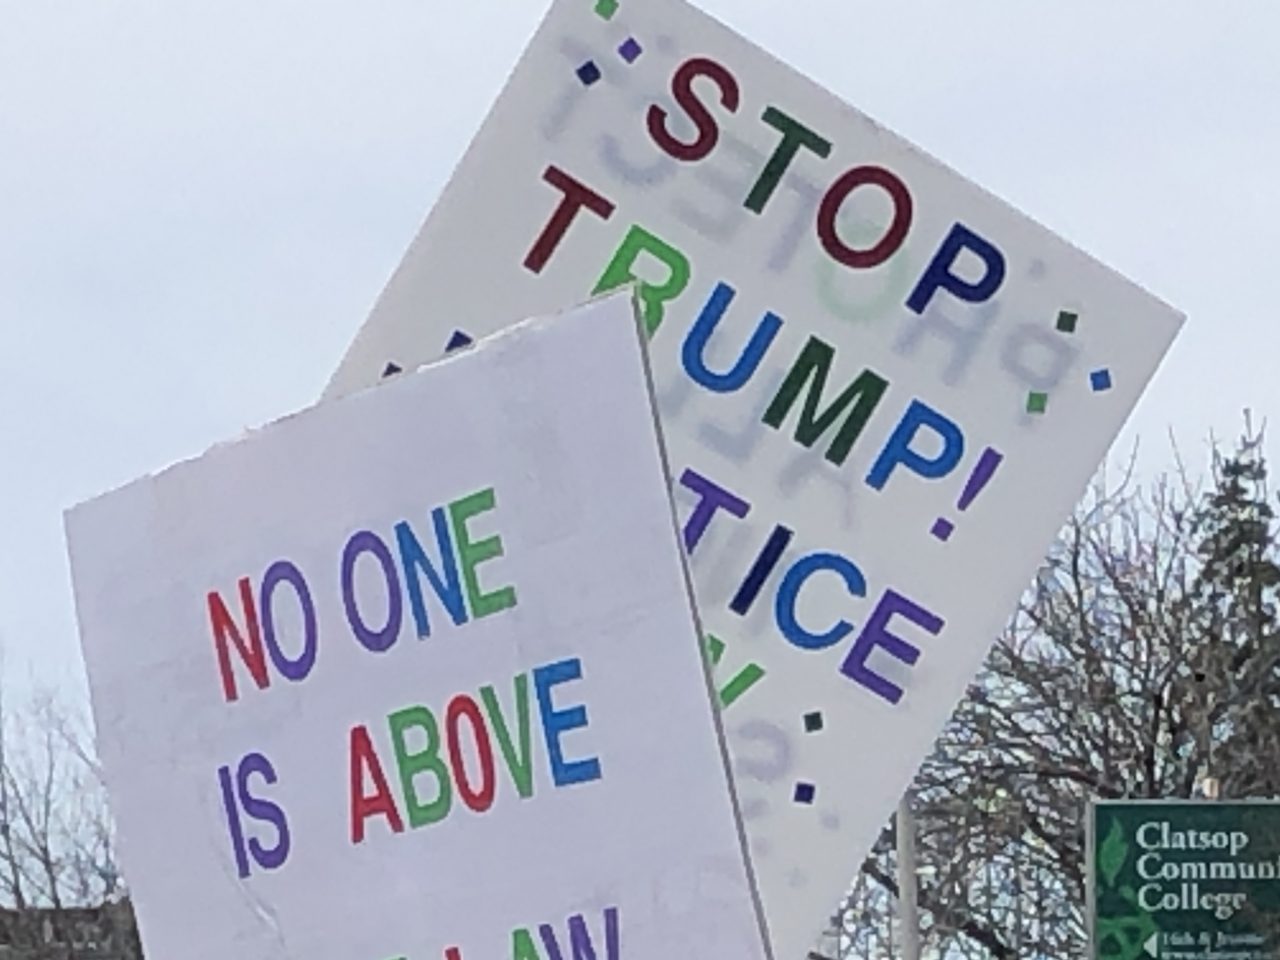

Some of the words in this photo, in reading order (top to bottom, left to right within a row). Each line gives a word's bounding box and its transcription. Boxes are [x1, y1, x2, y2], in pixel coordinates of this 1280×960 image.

[646, 57, 1006, 315] STOP
[523, 164, 1002, 541] TRUMP!
[208, 561, 317, 702] NO
[340, 487, 518, 653] ONE
[680, 467, 946, 705] TICE
[218, 752, 291, 879] IS
[350, 658, 602, 845] ABOVE
[1136, 822, 1248, 856] Clatsop
[1138, 882, 1247, 920] College
